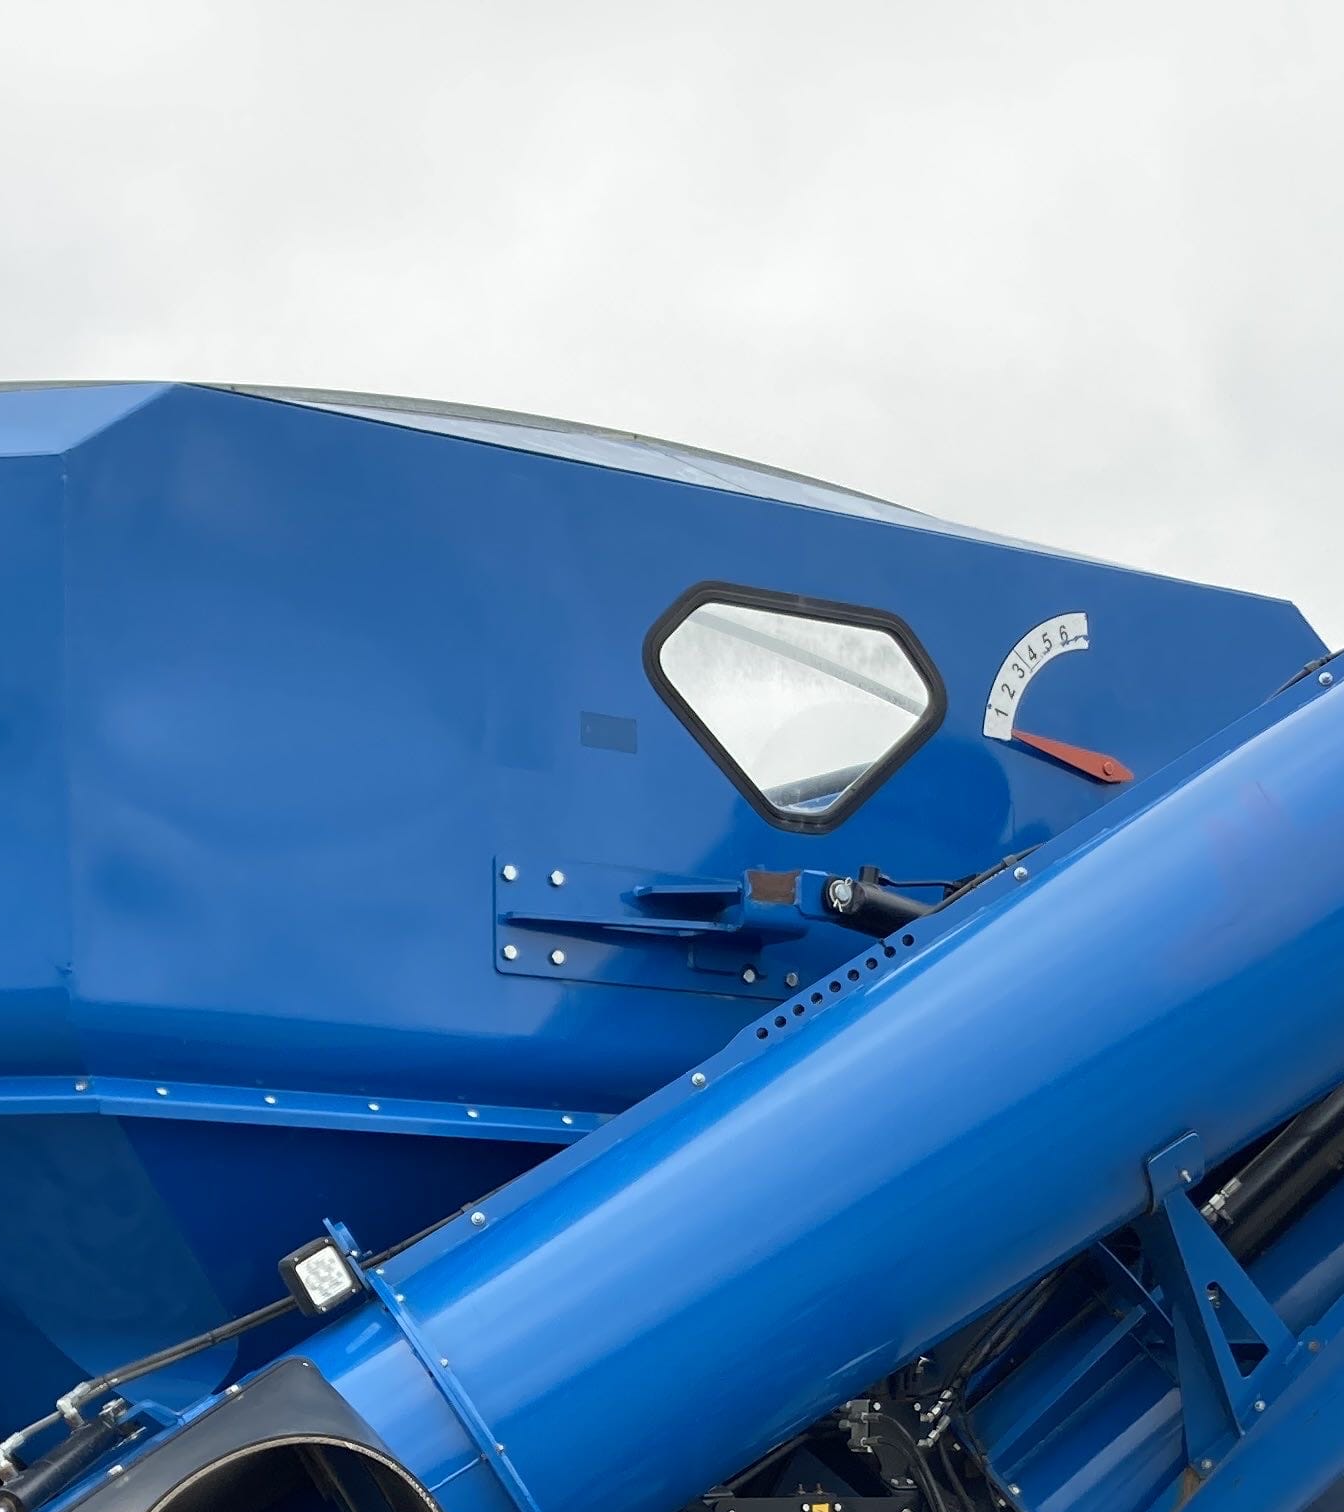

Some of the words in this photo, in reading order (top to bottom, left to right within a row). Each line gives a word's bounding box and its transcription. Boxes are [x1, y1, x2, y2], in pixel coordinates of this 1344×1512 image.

[1059, 625, 1069, 643] 6
[1041, 632, 1053, 653] 5
[1027, 645, 1037, 661] 4
[1012, 663, 1025, 679] 3
[1001, 683, 1016, 699] 2
[994, 707, 1009, 717] 1
